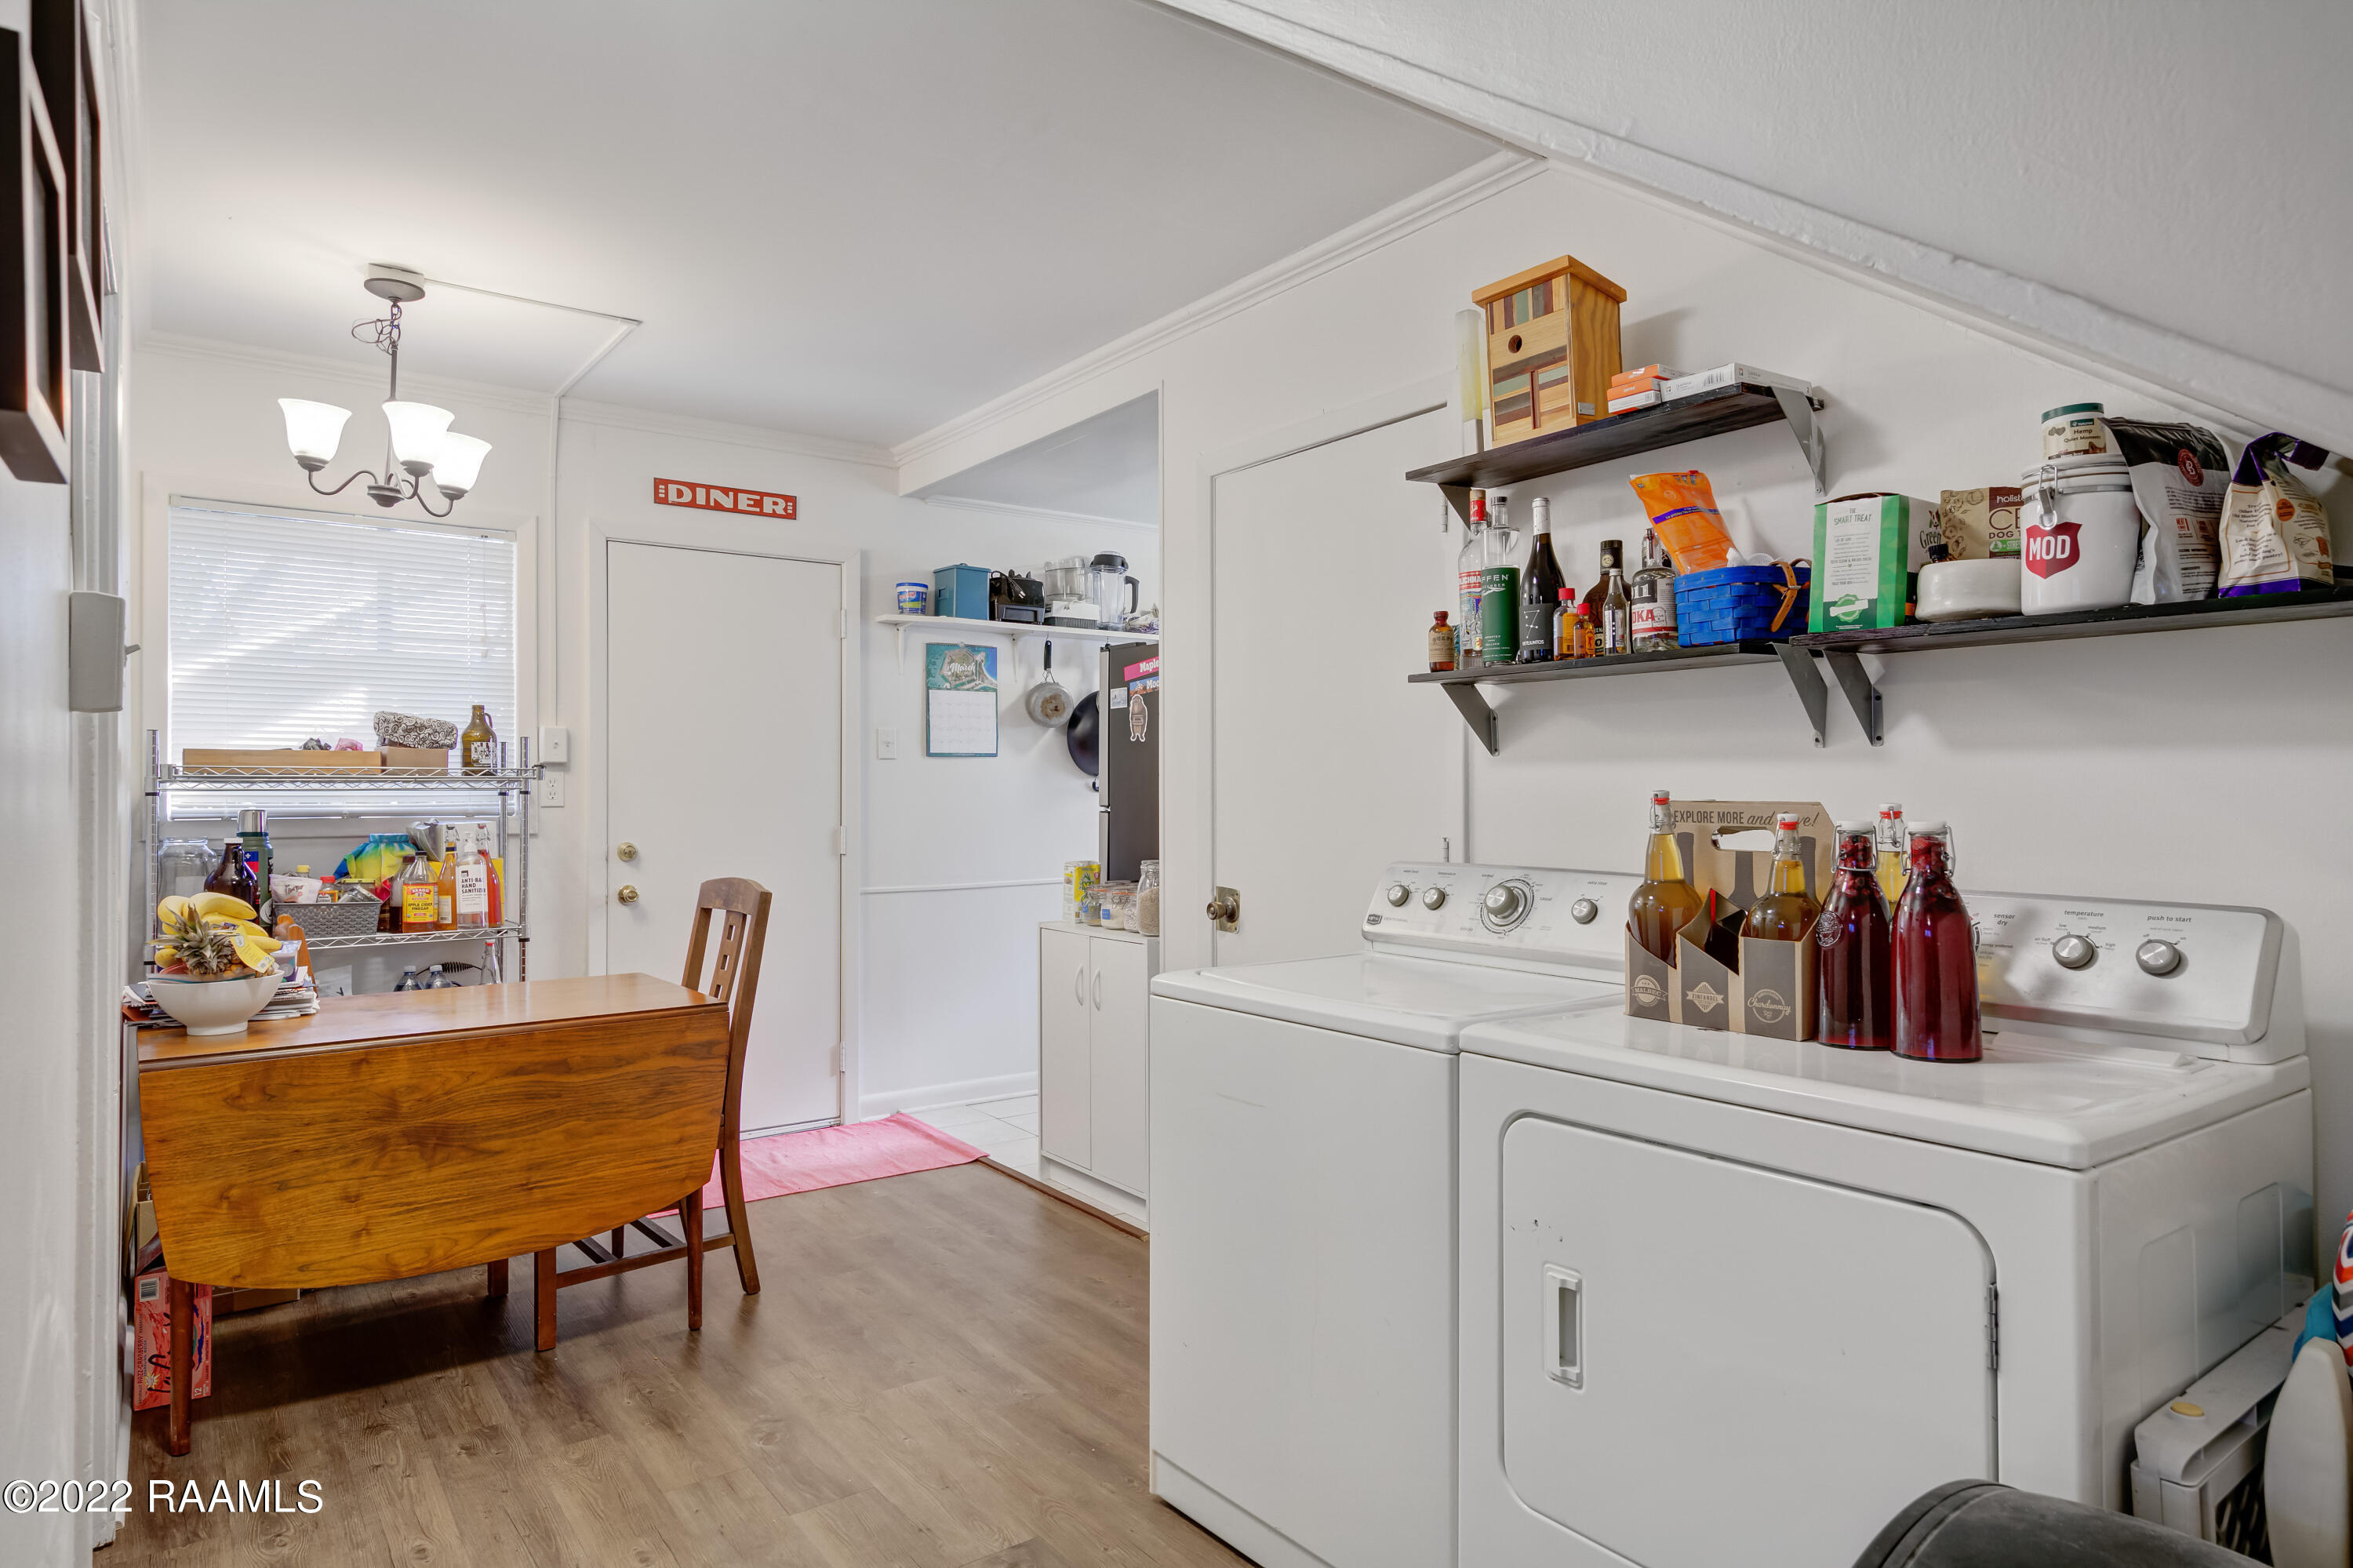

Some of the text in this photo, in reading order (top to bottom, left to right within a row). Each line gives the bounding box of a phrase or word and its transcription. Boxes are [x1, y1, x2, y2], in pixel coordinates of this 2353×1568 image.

[667, 483, 787, 515] DINER
[1834, 515, 1852, 526] SMART
[1919, 530, 1941, 549] Green
[1989, 531, 2014, 540] DOG
[2029, 535, 2071, 561] MOD
[1481, 574, 1509, 583] FFEN
[1632, 609, 1656, 624] DKA
[947, 662, 976, 675] March
[1674, 810, 1715, 824] EXPLORE
[1717, 811, 1744, 824] MORE
[1747, 810, 1777, 826] and
[1634, 986, 1662, 997] MALBEC
[1691, 993, 1719, 1002] ZINFANDEL
[1747, 997, 1791, 1016] Chardonnay
[194, 1386, 202, 1396] 12
